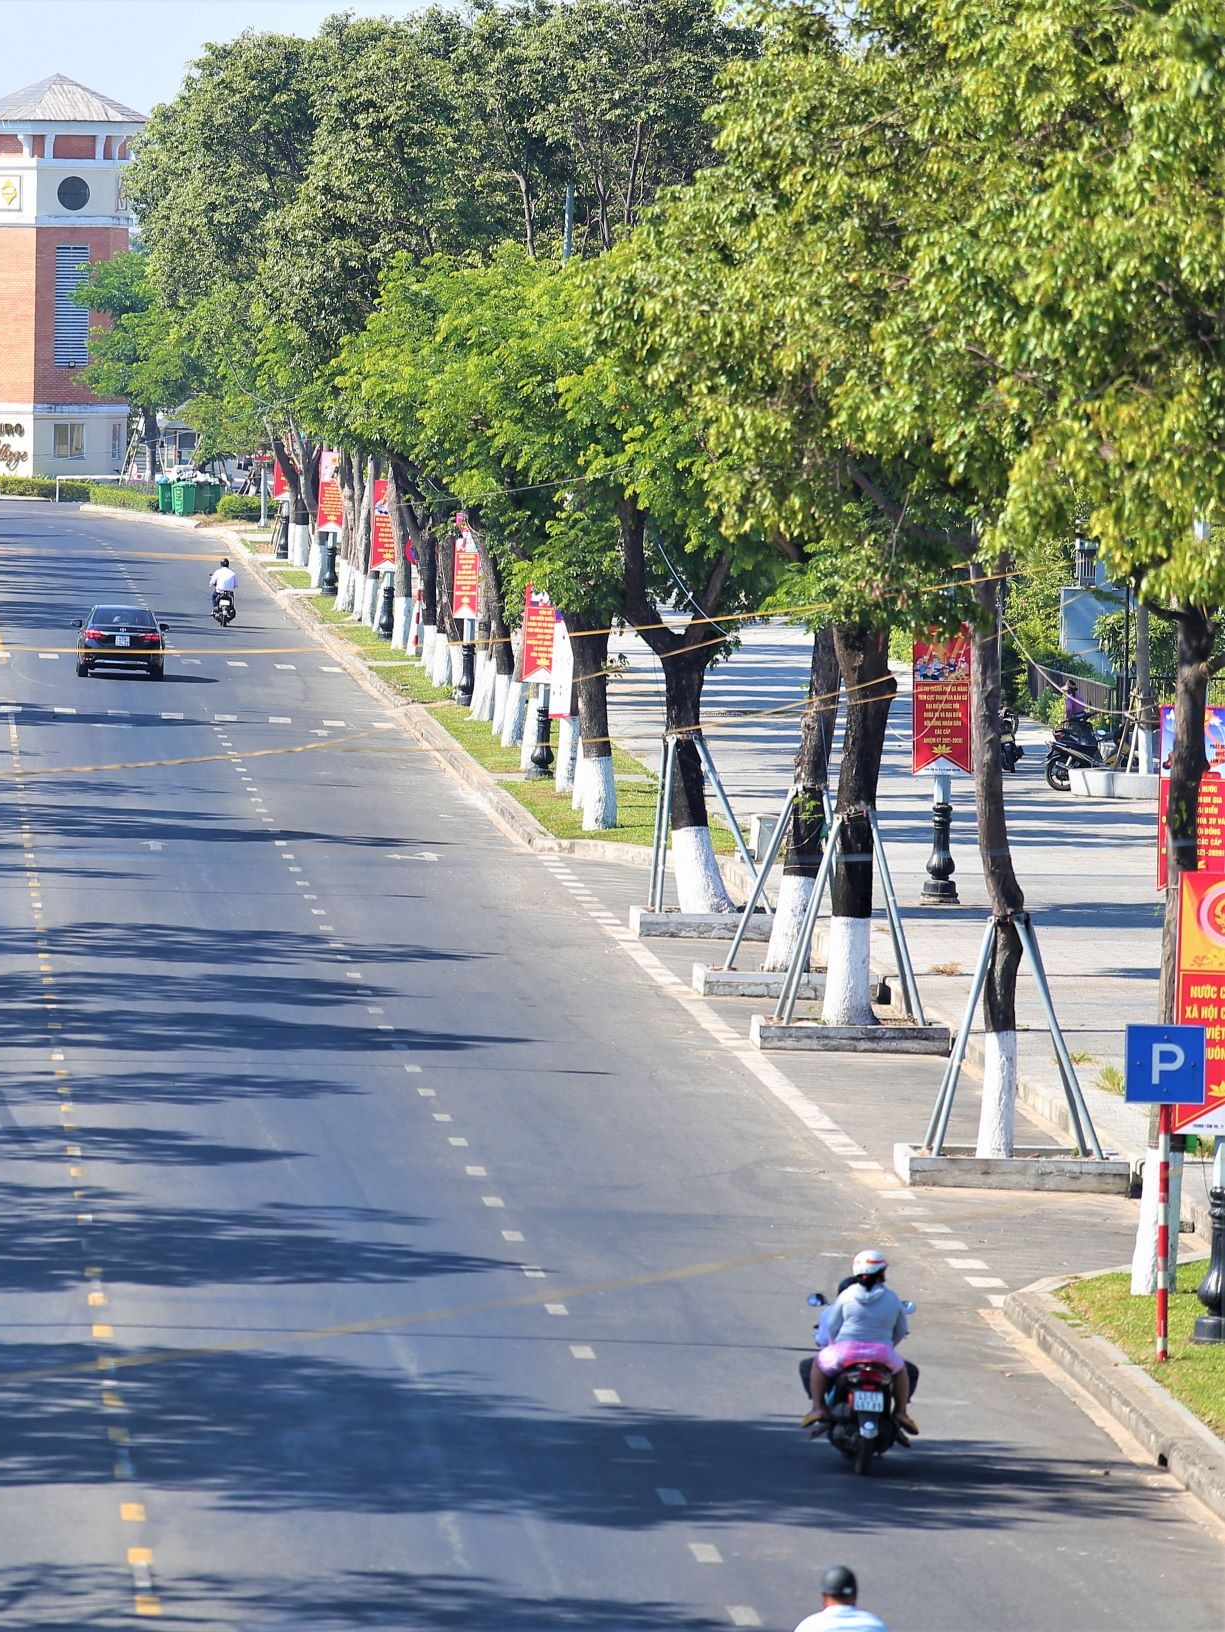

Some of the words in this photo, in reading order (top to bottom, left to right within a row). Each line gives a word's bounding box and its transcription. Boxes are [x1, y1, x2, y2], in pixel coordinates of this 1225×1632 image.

[1190, 984, 1217, 999] NƯỚC
[1185, 1004, 1198, 1018] XÃ
[1201, 1004, 1218, 1022] HỘI
[1152, 1043, 1185, 1085] P
